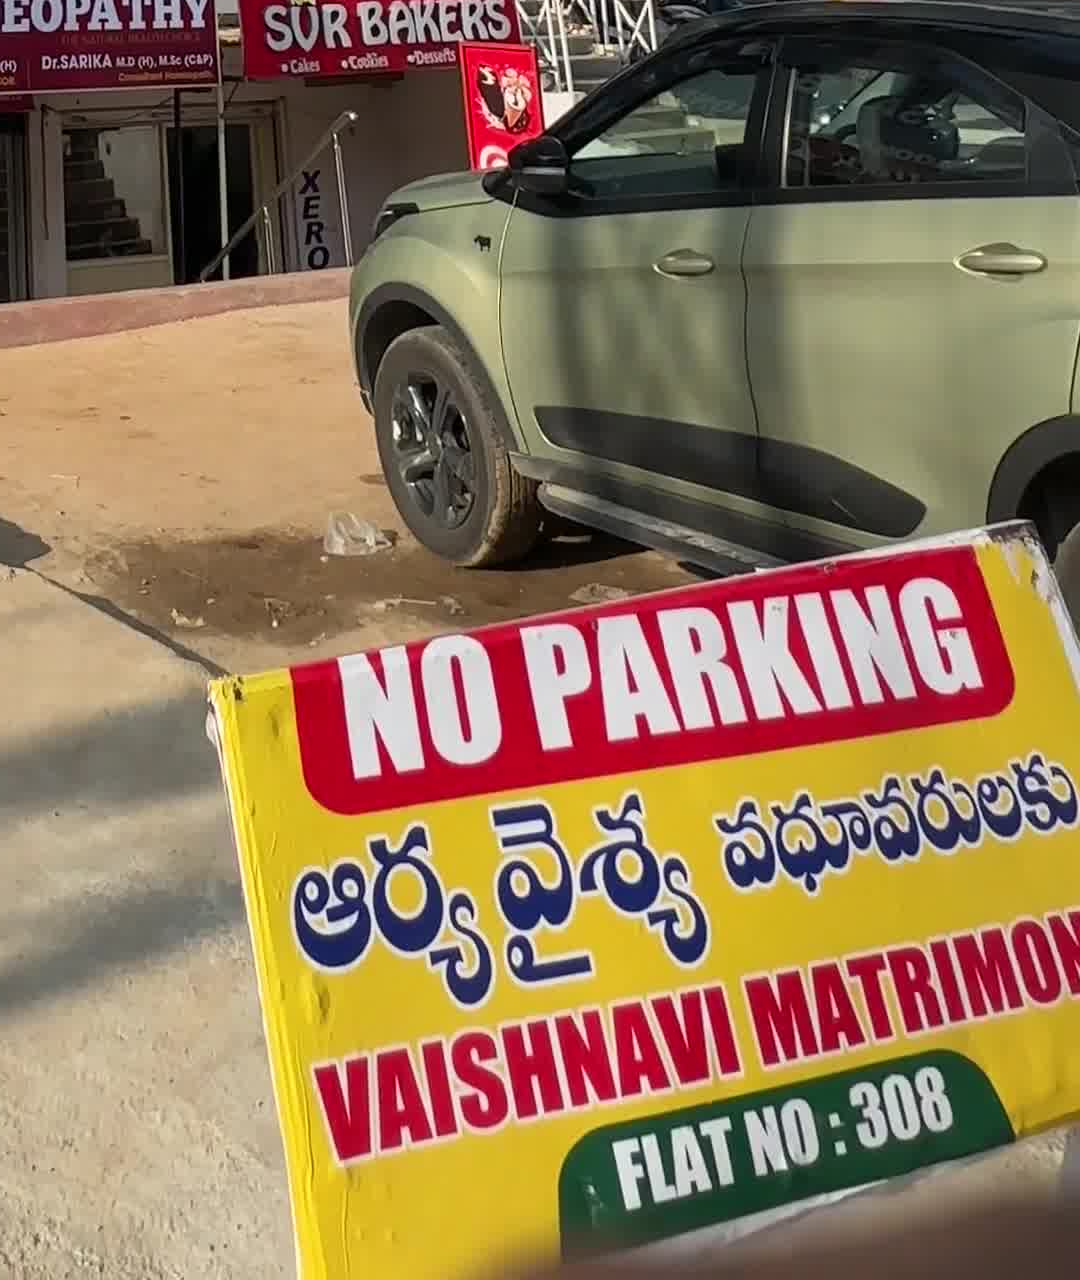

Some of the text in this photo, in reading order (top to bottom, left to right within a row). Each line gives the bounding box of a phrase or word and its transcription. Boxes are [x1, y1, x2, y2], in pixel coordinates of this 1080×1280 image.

[0, 60, 17, 73] (H)
[41, 53, 112, 71] Dr.SARIKA
[290, 48, 457, 74] Cakes Cookies Desserts
[337, 578, 984, 780] NO PARKING
[291, 753, 1079, 1008] ఆర్య వైశ్య వధూవరులకు
[313, 985, 742, 1162] VAISHNAVI
[613, 1118, 734, 1212] FLAT
[849, 1066, 953, 1150] 308
